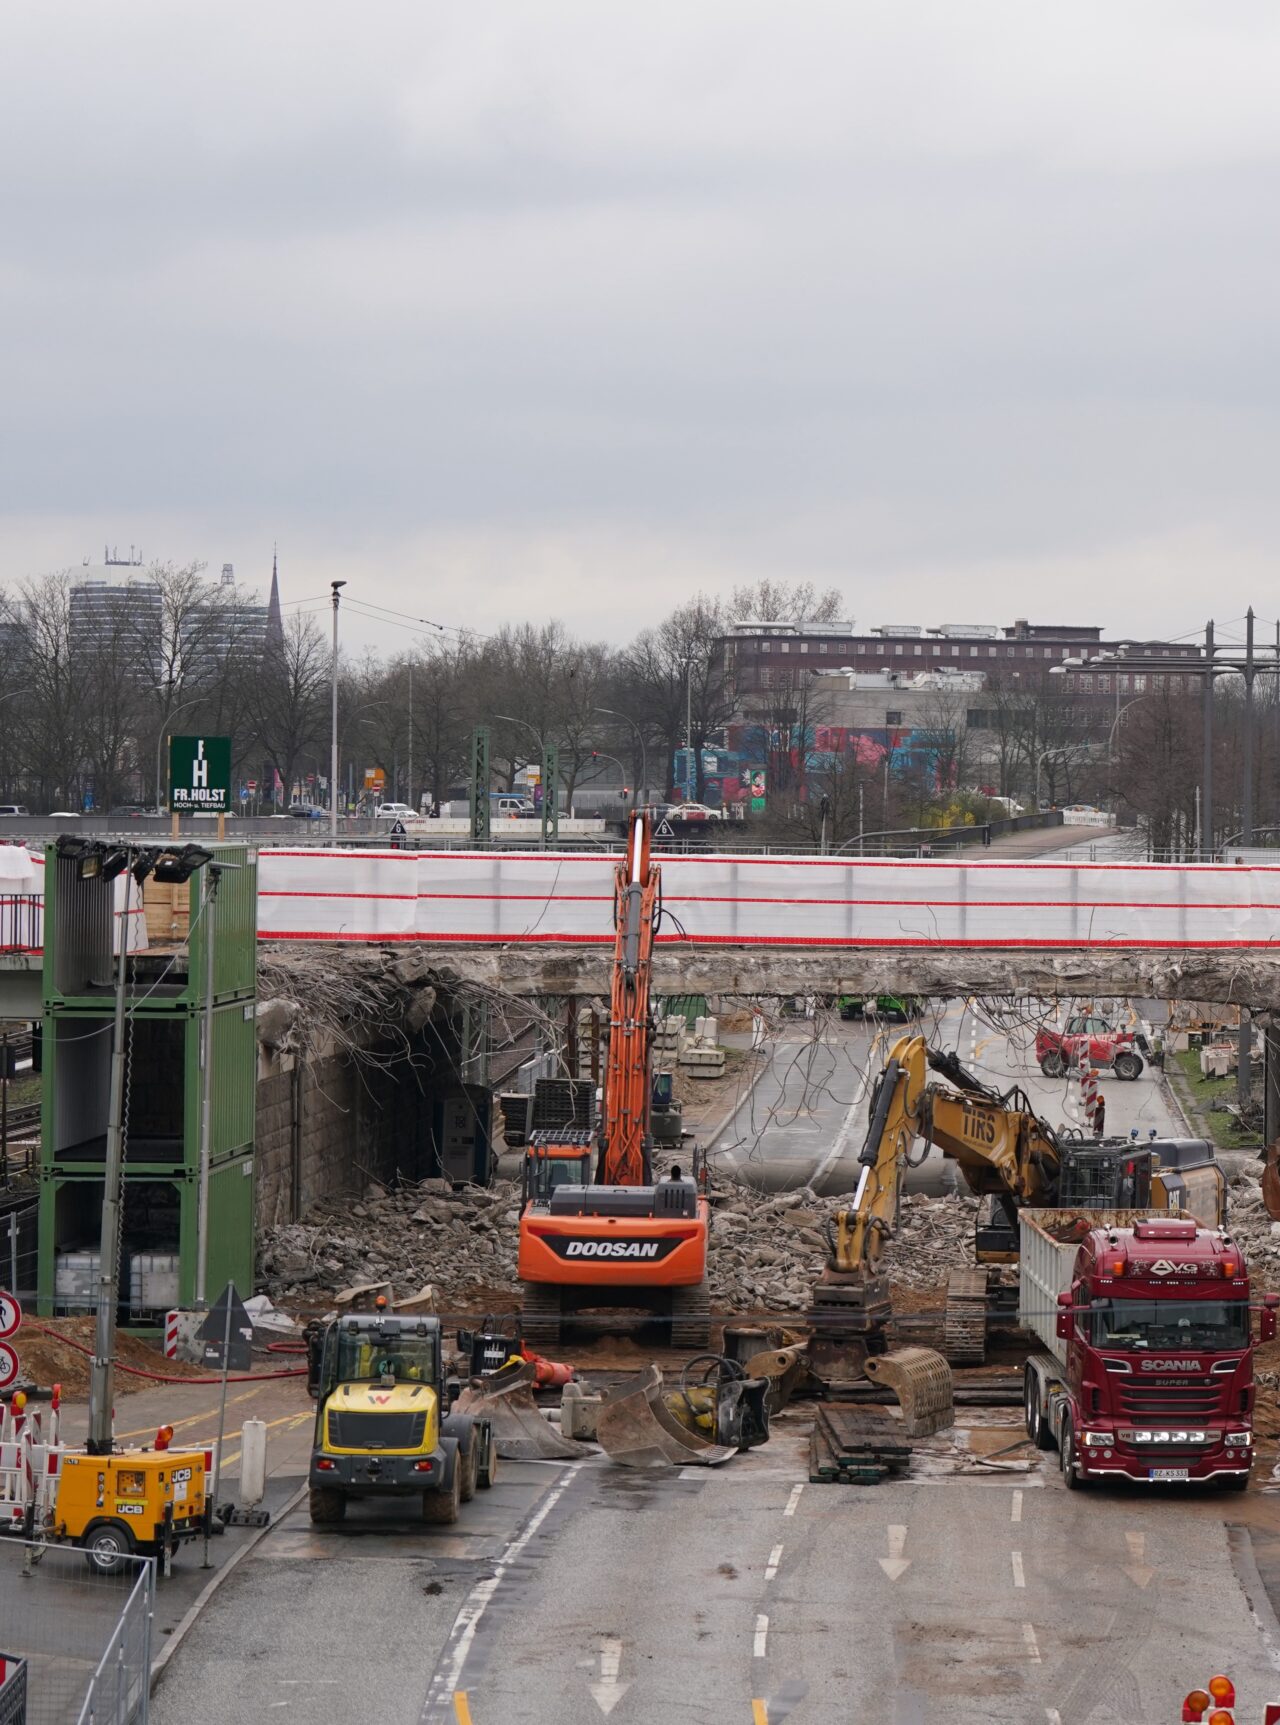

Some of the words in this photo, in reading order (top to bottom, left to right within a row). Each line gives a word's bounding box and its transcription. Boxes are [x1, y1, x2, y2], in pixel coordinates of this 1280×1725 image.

[174, 789, 225, 801] FR.HOLST
[396, 824, 401, 832] 6
[661, 825, 667, 834] 6
[565, 1242, 659, 1257] DOOSAN
[1150, 1260, 1199, 1274] AVG
[1141, 1360, 1201, 1371] SCANIA
[172, 1469, 192, 1482] JCB
[117, 1505, 144, 1514] JCB
